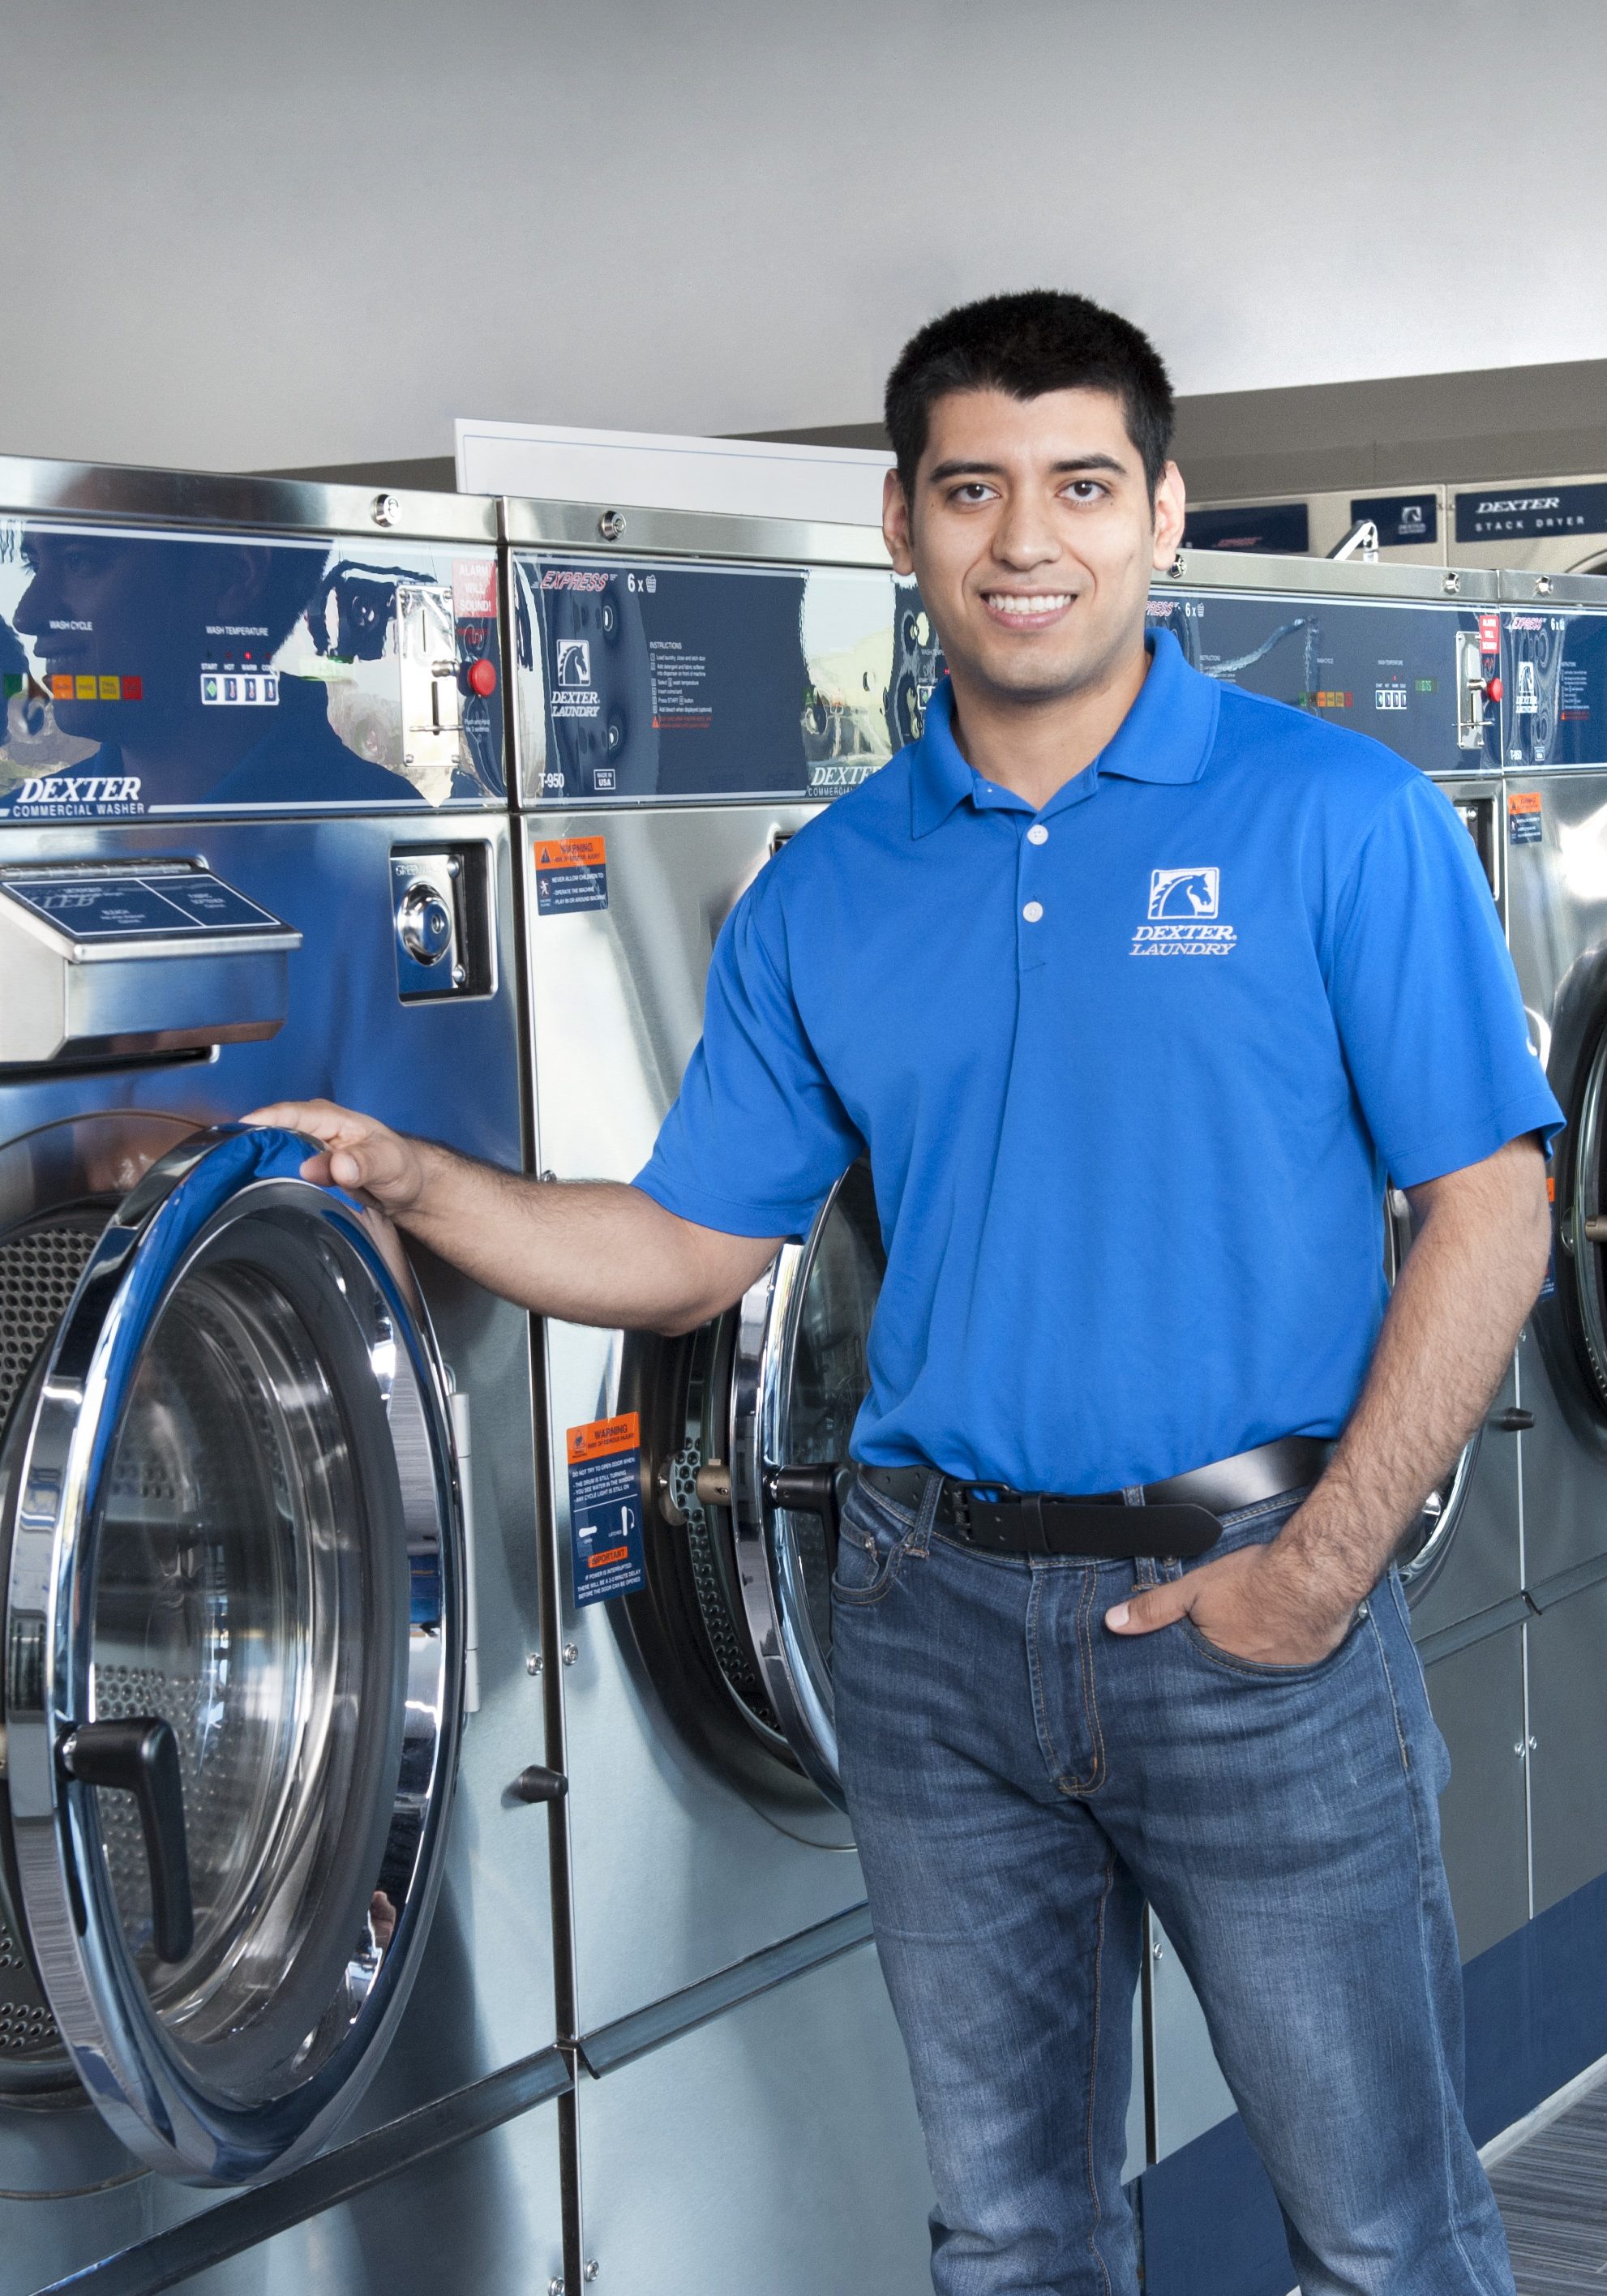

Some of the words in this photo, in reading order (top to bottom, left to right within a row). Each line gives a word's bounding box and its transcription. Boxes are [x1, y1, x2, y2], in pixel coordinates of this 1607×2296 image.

[1476, 497, 1560, 514] DEXTER
[1475, 520, 1524, 532] STACK
[1536, 516, 1584, 528] DRYER
[540, 570, 609, 592] EXPRESS
[628, 573, 636, 593] 6
[1185, 602, 1191, 617] 6
[49, 620, 70, 630] WASH
[71, 621, 93, 631] CYCLE
[206, 625, 224, 635] WASH
[225, 626, 269, 636] TEMPERATURE
[649, 641, 683, 649] INSTRUCTIONS
[551, 692, 598, 704] DEXTER
[551, 706, 601, 718] LAUNDRY
[538, 773, 565, 788] T-950
[598, 778, 611, 786] USA
[16, 777, 141, 803] DEXTER
[808, 787, 853, 797] COMMERCIA
[13, 804, 92, 817] COMMERCIAL
[96, 803, 144, 815] WASHER
[1129, 943, 1236, 956] LAUNDRY
[594, 1424, 628, 1440] WARNING
[601, 1463, 612, 1471] OPEN
[611, 1459, 623, 1467] DOOR
[610, 1469, 627, 1479] TURNING
[592, 1482, 606, 1491] WATER
[618, 1475, 635, 1484] WINDOW
[585, 1492, 597, 1501] CYCLE
[597, 1489, 608, 1497] LIGHT
[592, 1549, 624, 1564] IMPORTANT
[589, 1570, 603, 1579] POWER
[628, 1569, 641, 1577] DELAY
[578, 1590, 594, 1600] BEFORE
[601, 1584, 612, 1593] DOOR
[625, 1576, 641, 1585] OPENED
